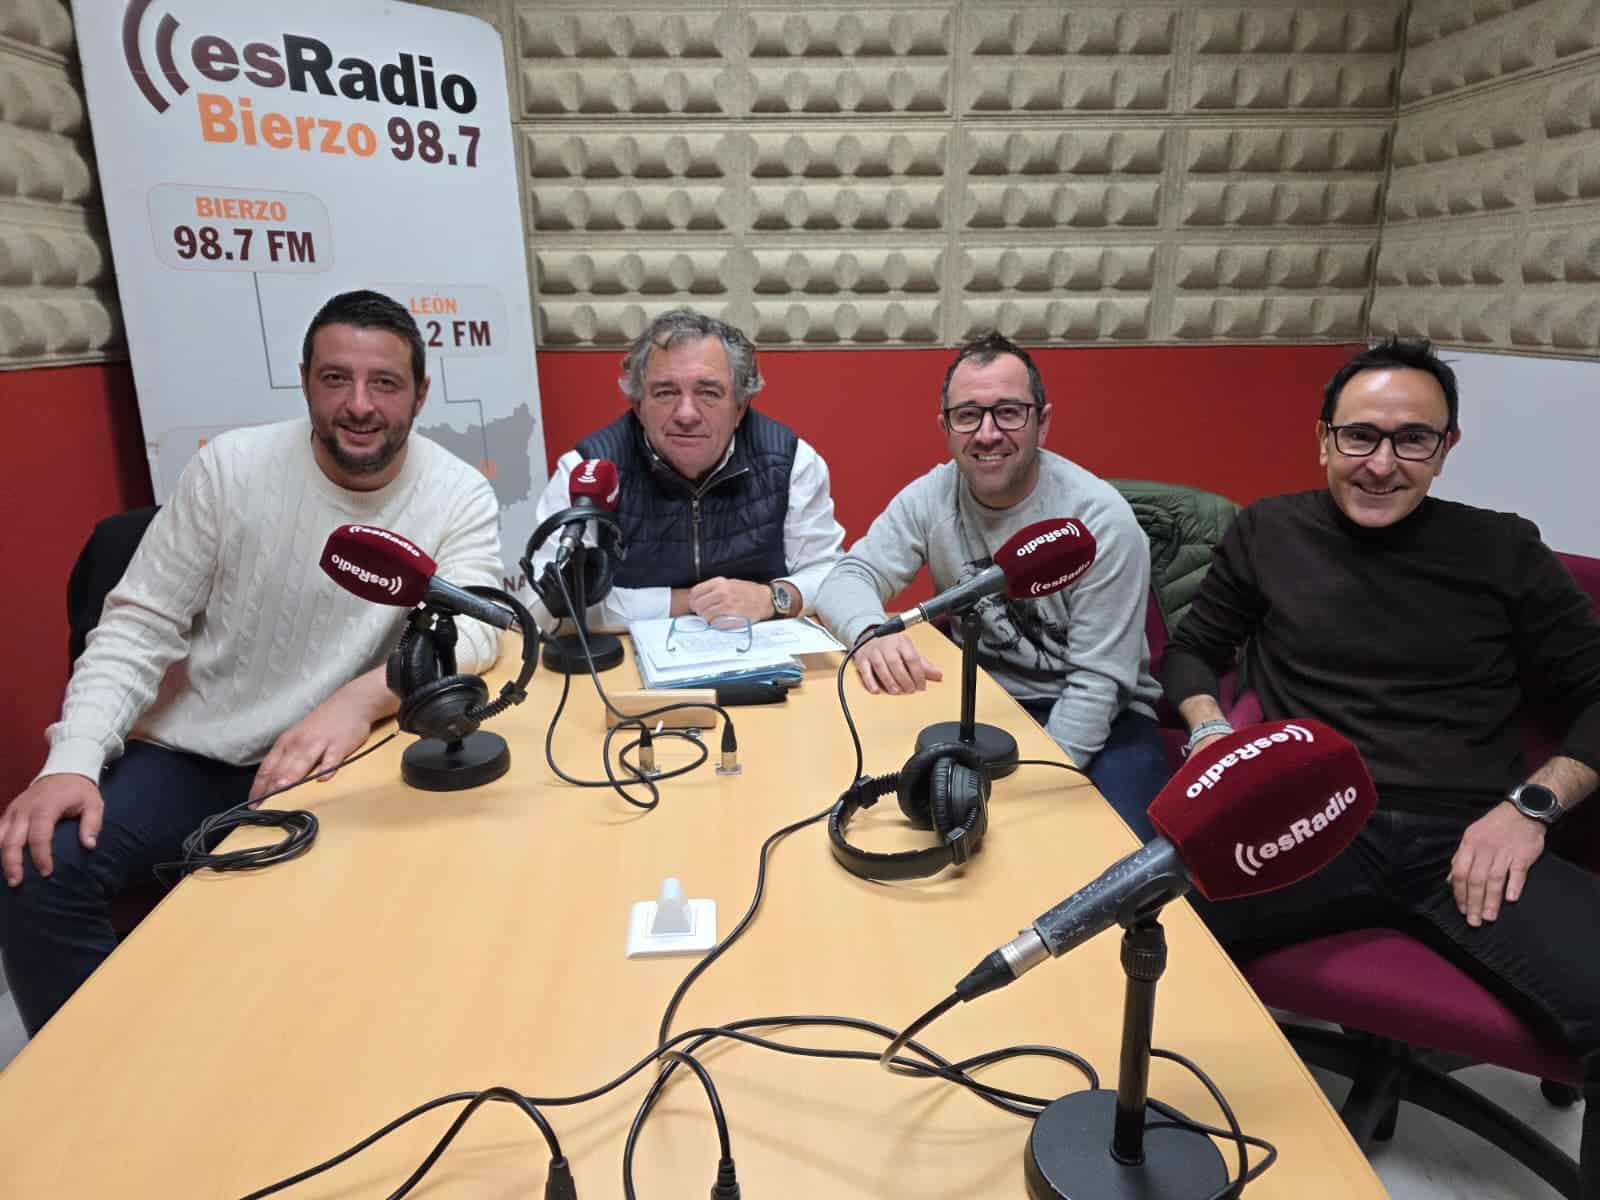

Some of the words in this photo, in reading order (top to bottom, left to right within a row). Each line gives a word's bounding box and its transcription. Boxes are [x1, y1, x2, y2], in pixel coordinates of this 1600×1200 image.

[191, 33, 478, 115] esRadio
[197, 93, 377, 157] Bierzo
[387, 116, 481, 168] 98.7
[194, 196, 287, 222] BIERZO
[173, 225, 254, 262] 98.7
[267, 230, 316, 263] FM
[409, 290, 457, 315] LEÓN
[452, 320, 491, 347] FM
[1016, 527, 1070, 557] esRadio
[331, 553, 390, 588] esRadio
[1042, 560, 1091, 590] esRadio
[1186, 731, 1290, 799] esRadio
[1258, 786, 1358, 860] esRadio
